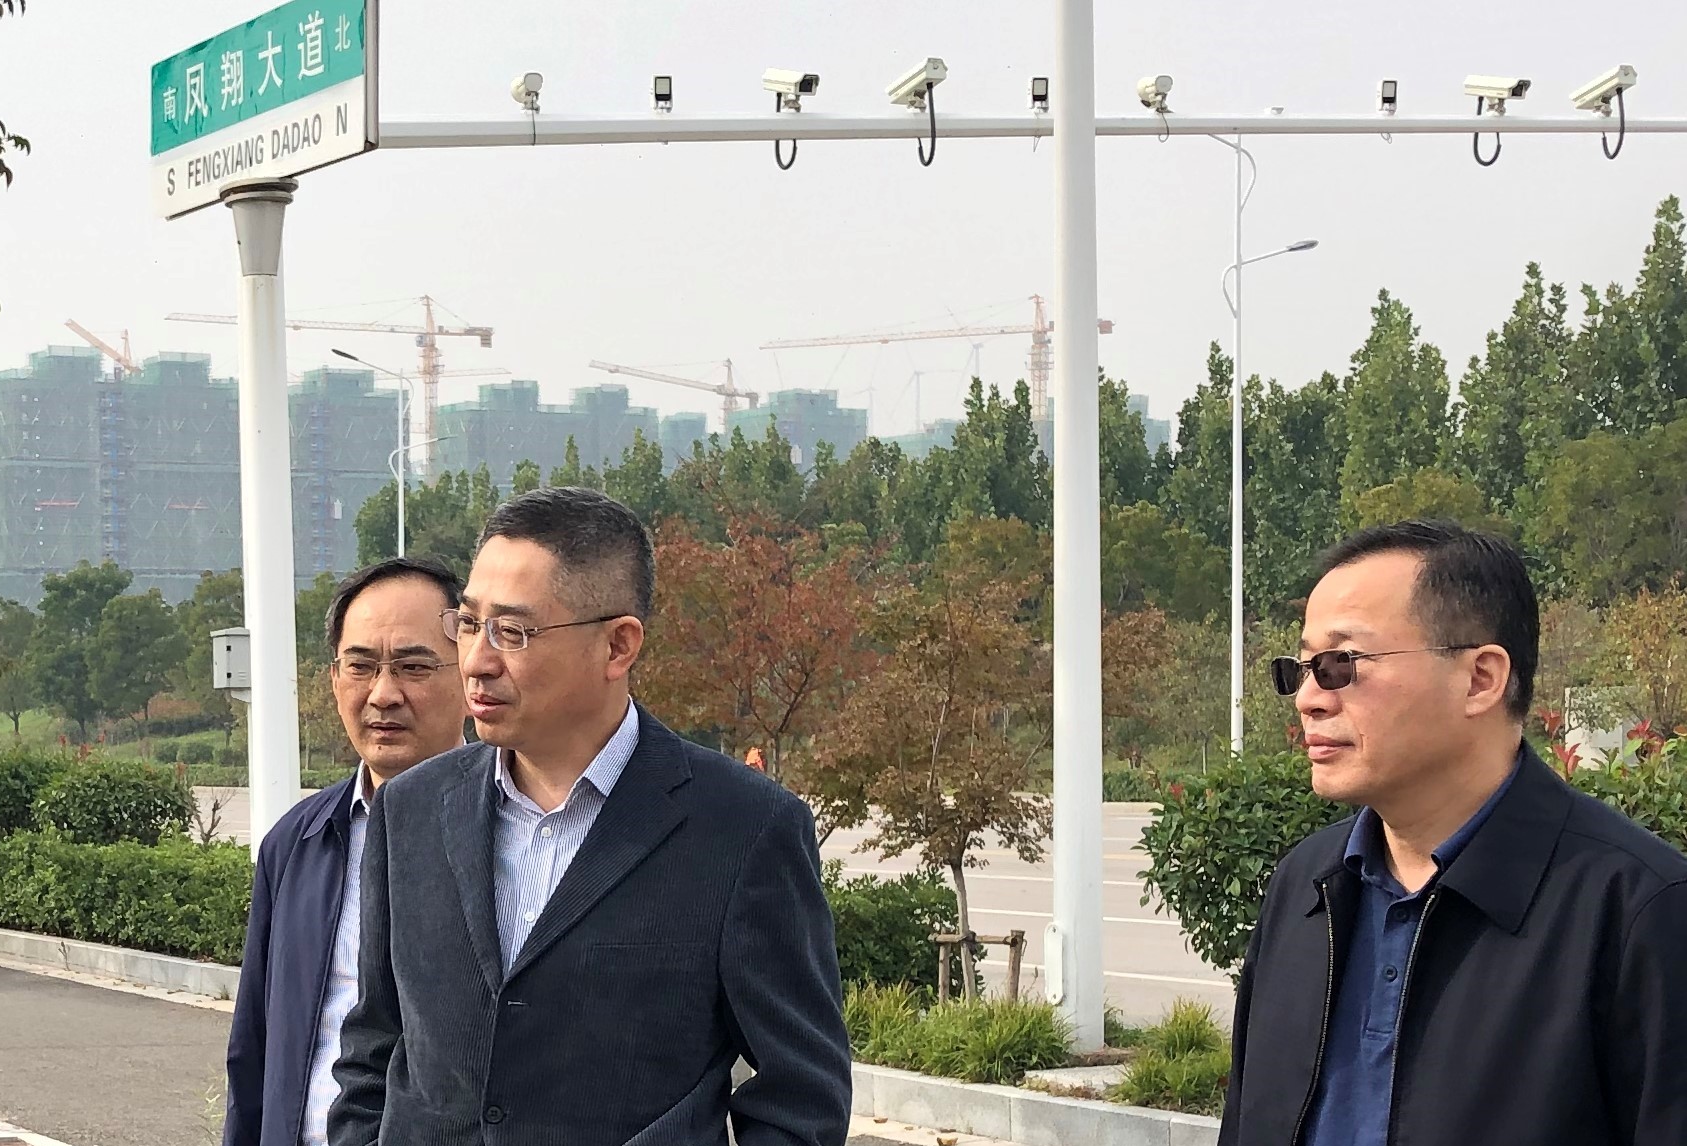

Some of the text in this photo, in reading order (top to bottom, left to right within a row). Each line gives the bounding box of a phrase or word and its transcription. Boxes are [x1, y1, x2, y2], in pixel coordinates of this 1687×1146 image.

[163, 11, 351, 125] 南 凤翔大道 北
[167, 102, 348, 197] S FENGXIANG DADAO N
